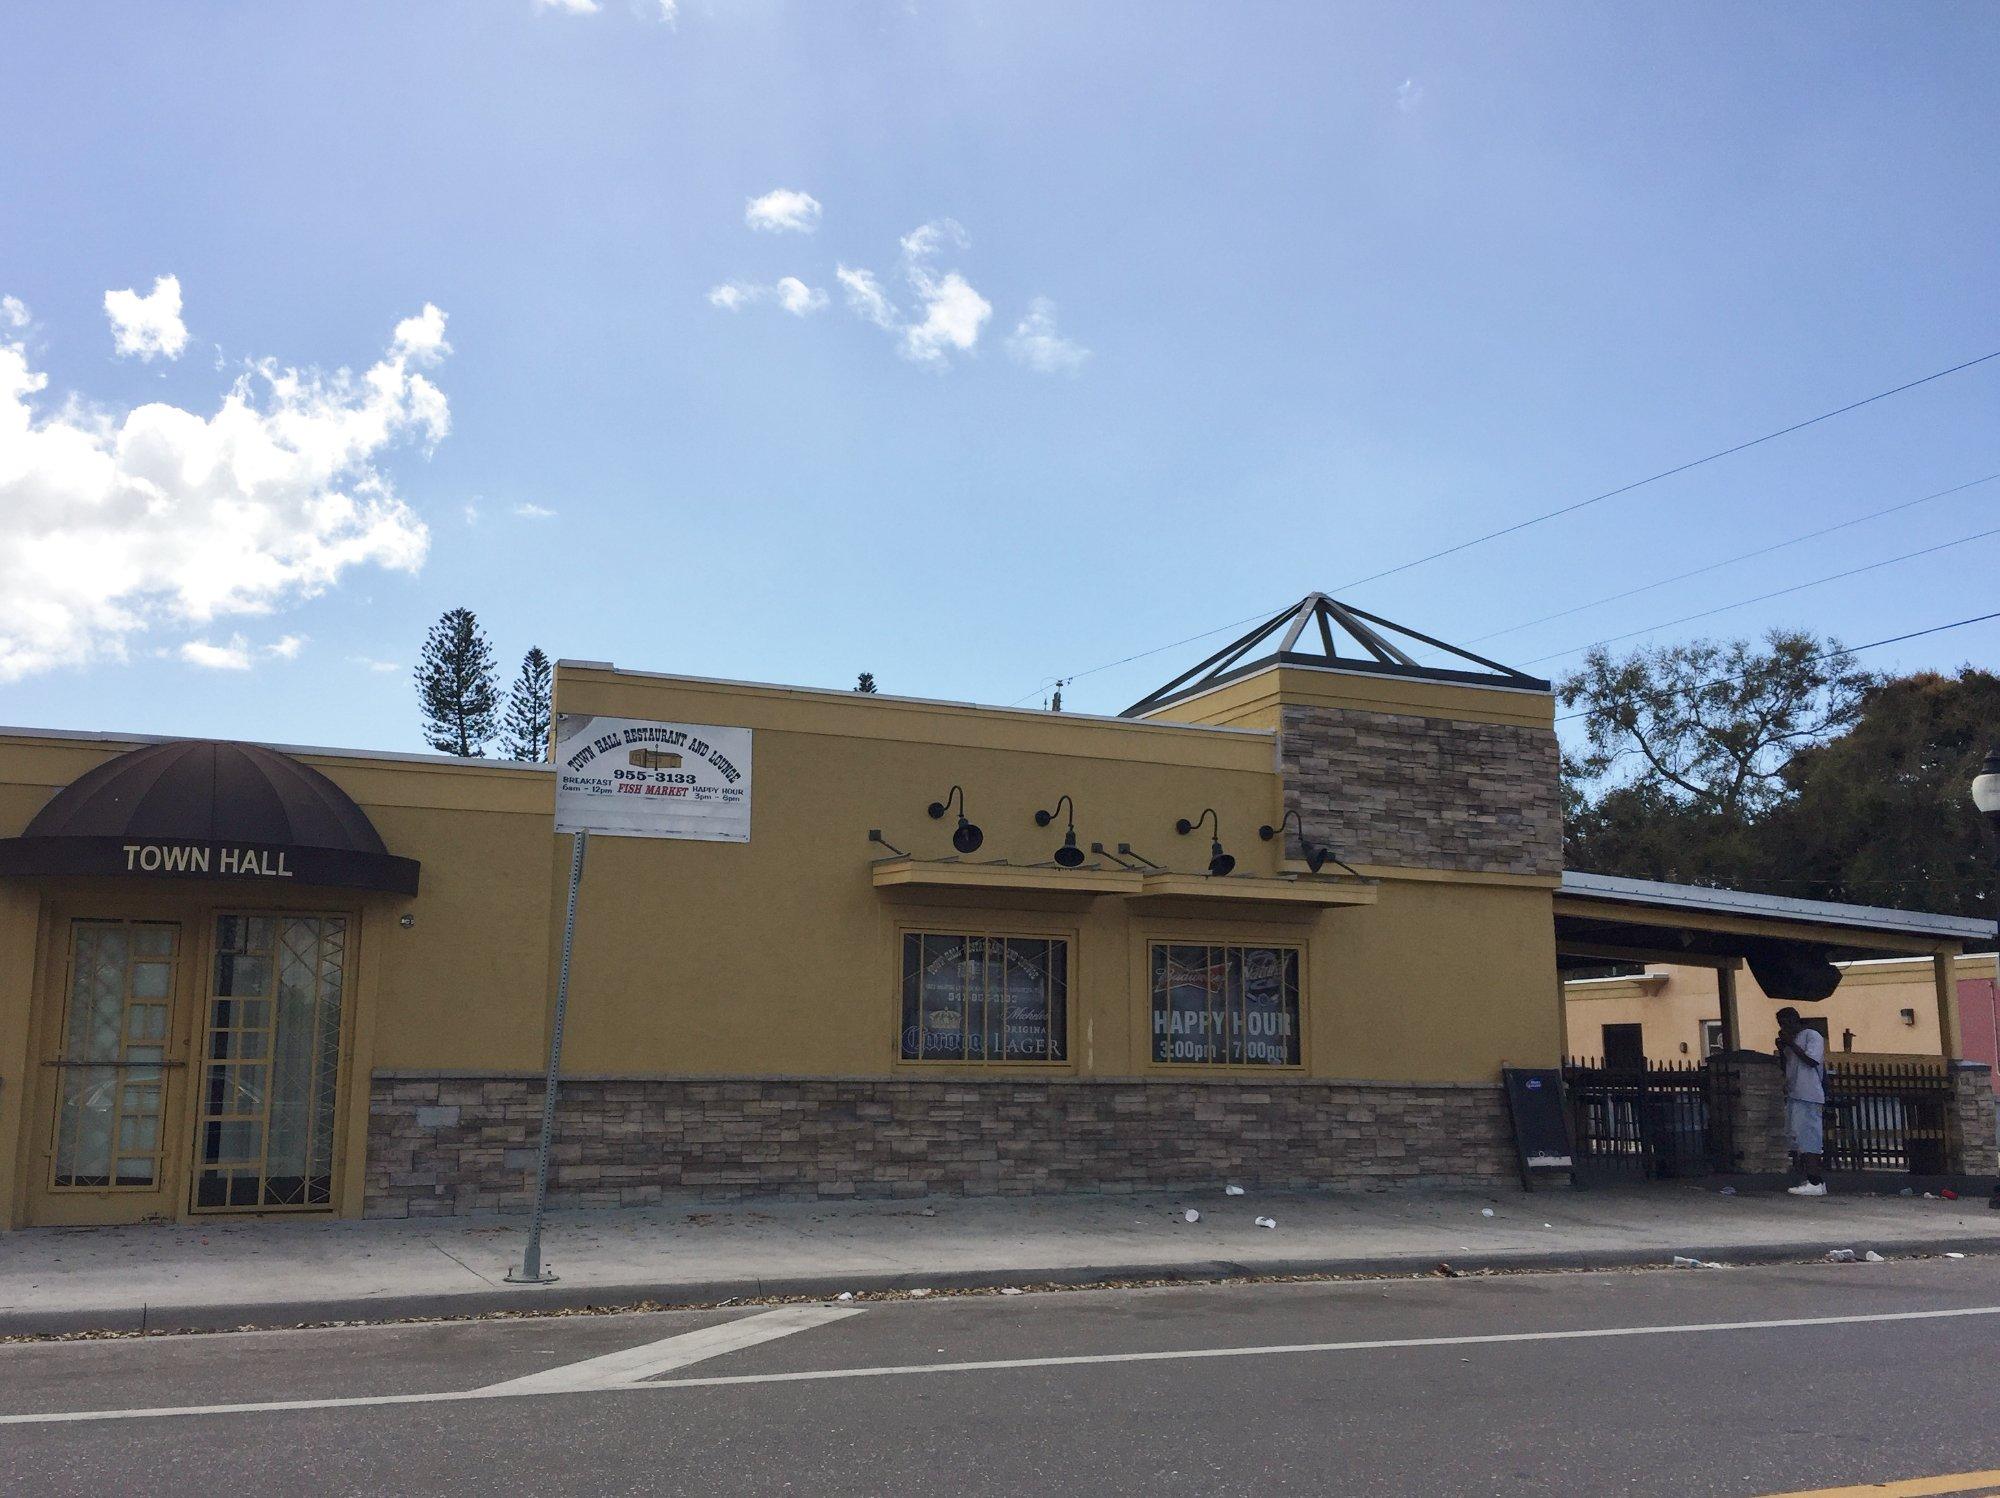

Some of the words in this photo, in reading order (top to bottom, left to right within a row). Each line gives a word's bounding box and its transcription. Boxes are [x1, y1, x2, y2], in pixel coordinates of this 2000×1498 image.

[567, 745, 597, 772] TOWN
[594, 732, 622, 754] HALL
[624, 727, 688, 747] RESTAURANT
[688, 735, 709, 757] AND
[708, 750, 741, 784] LOUNGE
[562, 776, 613, 786] BREAKFAST
[613, 769, 697, 784] 955-3133
[562, 784, 581, 792] 6am
[592, 785, 613, 795] 12pm
[617, 783, 643, 795] FISH
[645, 785, 689, 797] MARKET
[692, 786, 720, 795] HAPPY
[722, 787, 744, 796] HOUR
[695, 793, 712, 801] 3pm
[123, 845, 210, 872] TOWN
[220, 848, 293, 877] HALL
[1002, 1005, 1051, 1021] Michelo
[1005, 1024, 1051, 1034] ORIGINA
[1154, 1010, 1225, 1034] HAPPY
[1232, 1011, 1291, 1036] HOUR
[994, 1032, 1062, 1056] LAGER
[1160, 1041, 1217, 1061] 3:00pm
